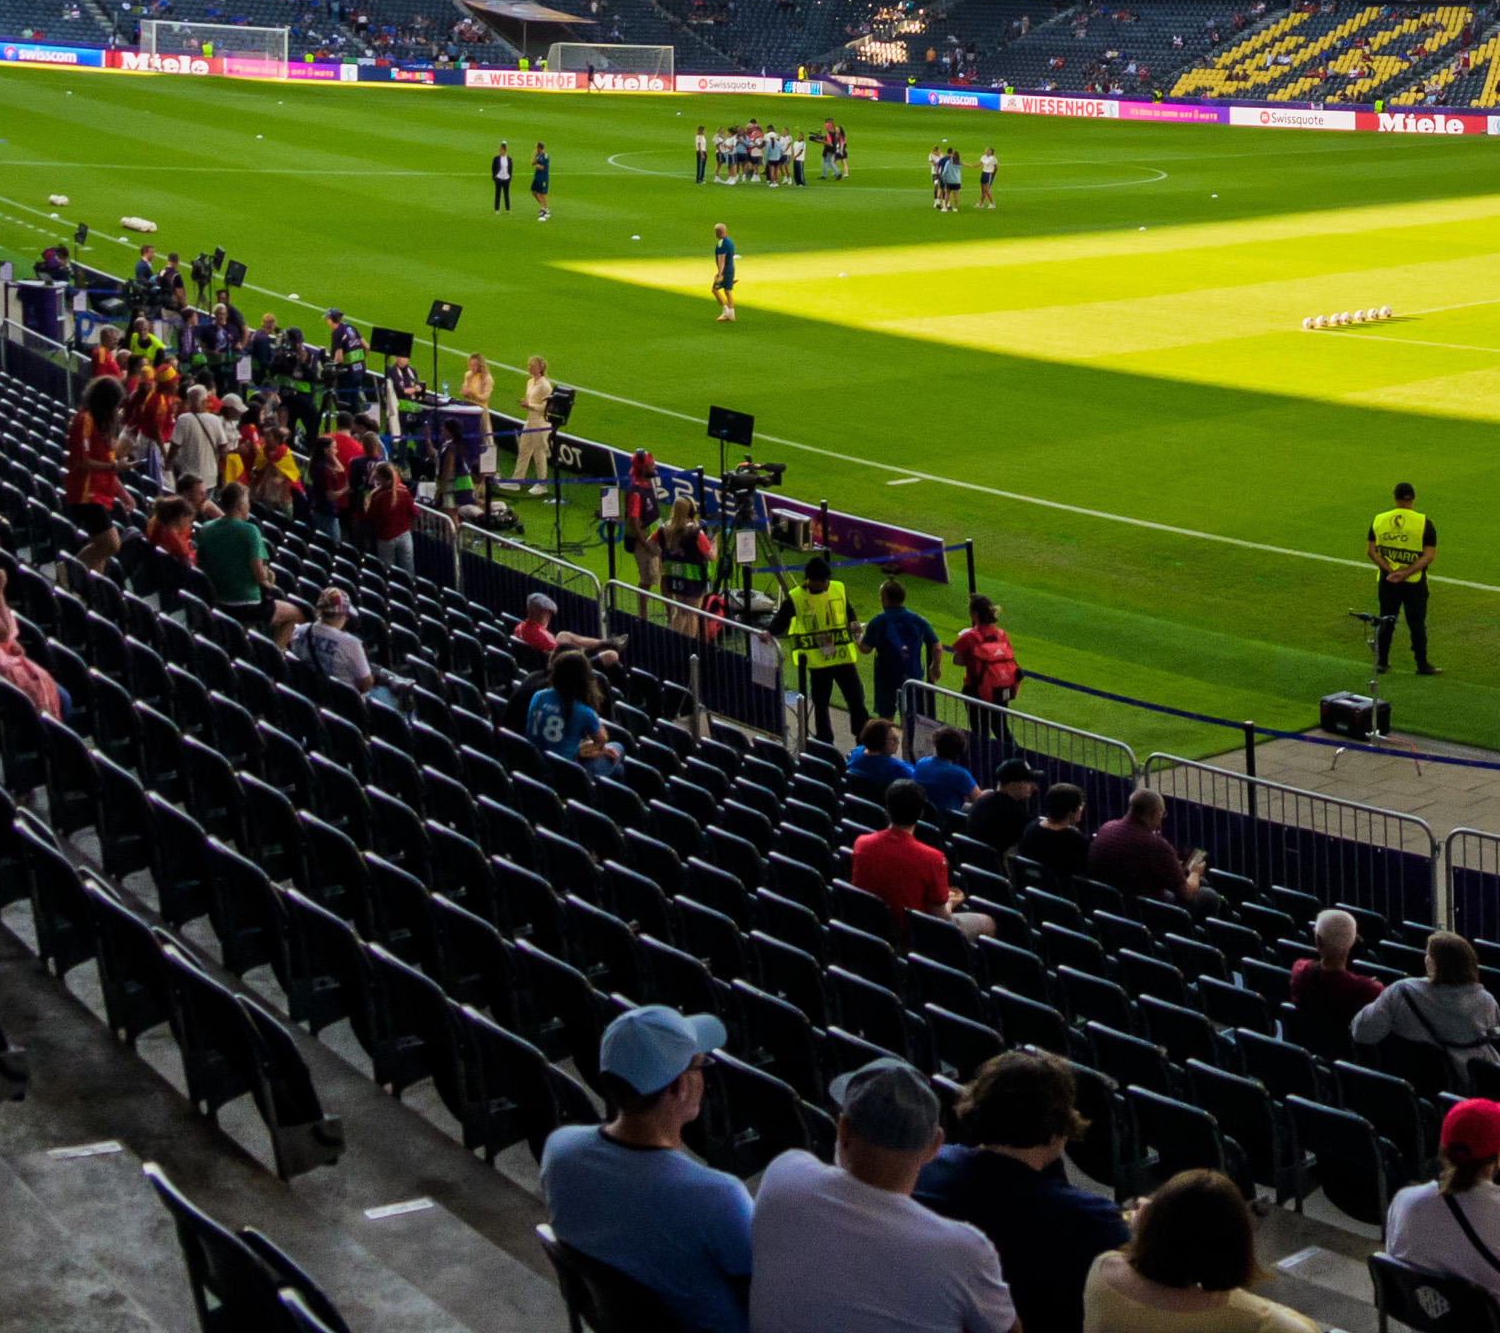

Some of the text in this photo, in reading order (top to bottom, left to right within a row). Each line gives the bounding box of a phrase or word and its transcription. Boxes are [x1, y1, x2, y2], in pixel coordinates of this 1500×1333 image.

[19, 48, 78, 64] swisscom
[121, 51, 209, 75] Miele
[490, 73, 575, 88] WIESENHOF
[591, 73, 665, 92] Miele
[709, 79, 757, 92] Swissquote
[938, 94, 978, 106] swisscom
[1022, 98, 1105, 117] WIESENHOF
[1130, 107, 1218, 120] It's time to come OFF MUTE
[1271, 112, 1324, 128] Swissquote
[1377, 113, 1465, 134] Miele
[532, 709, 566, 743] 18
